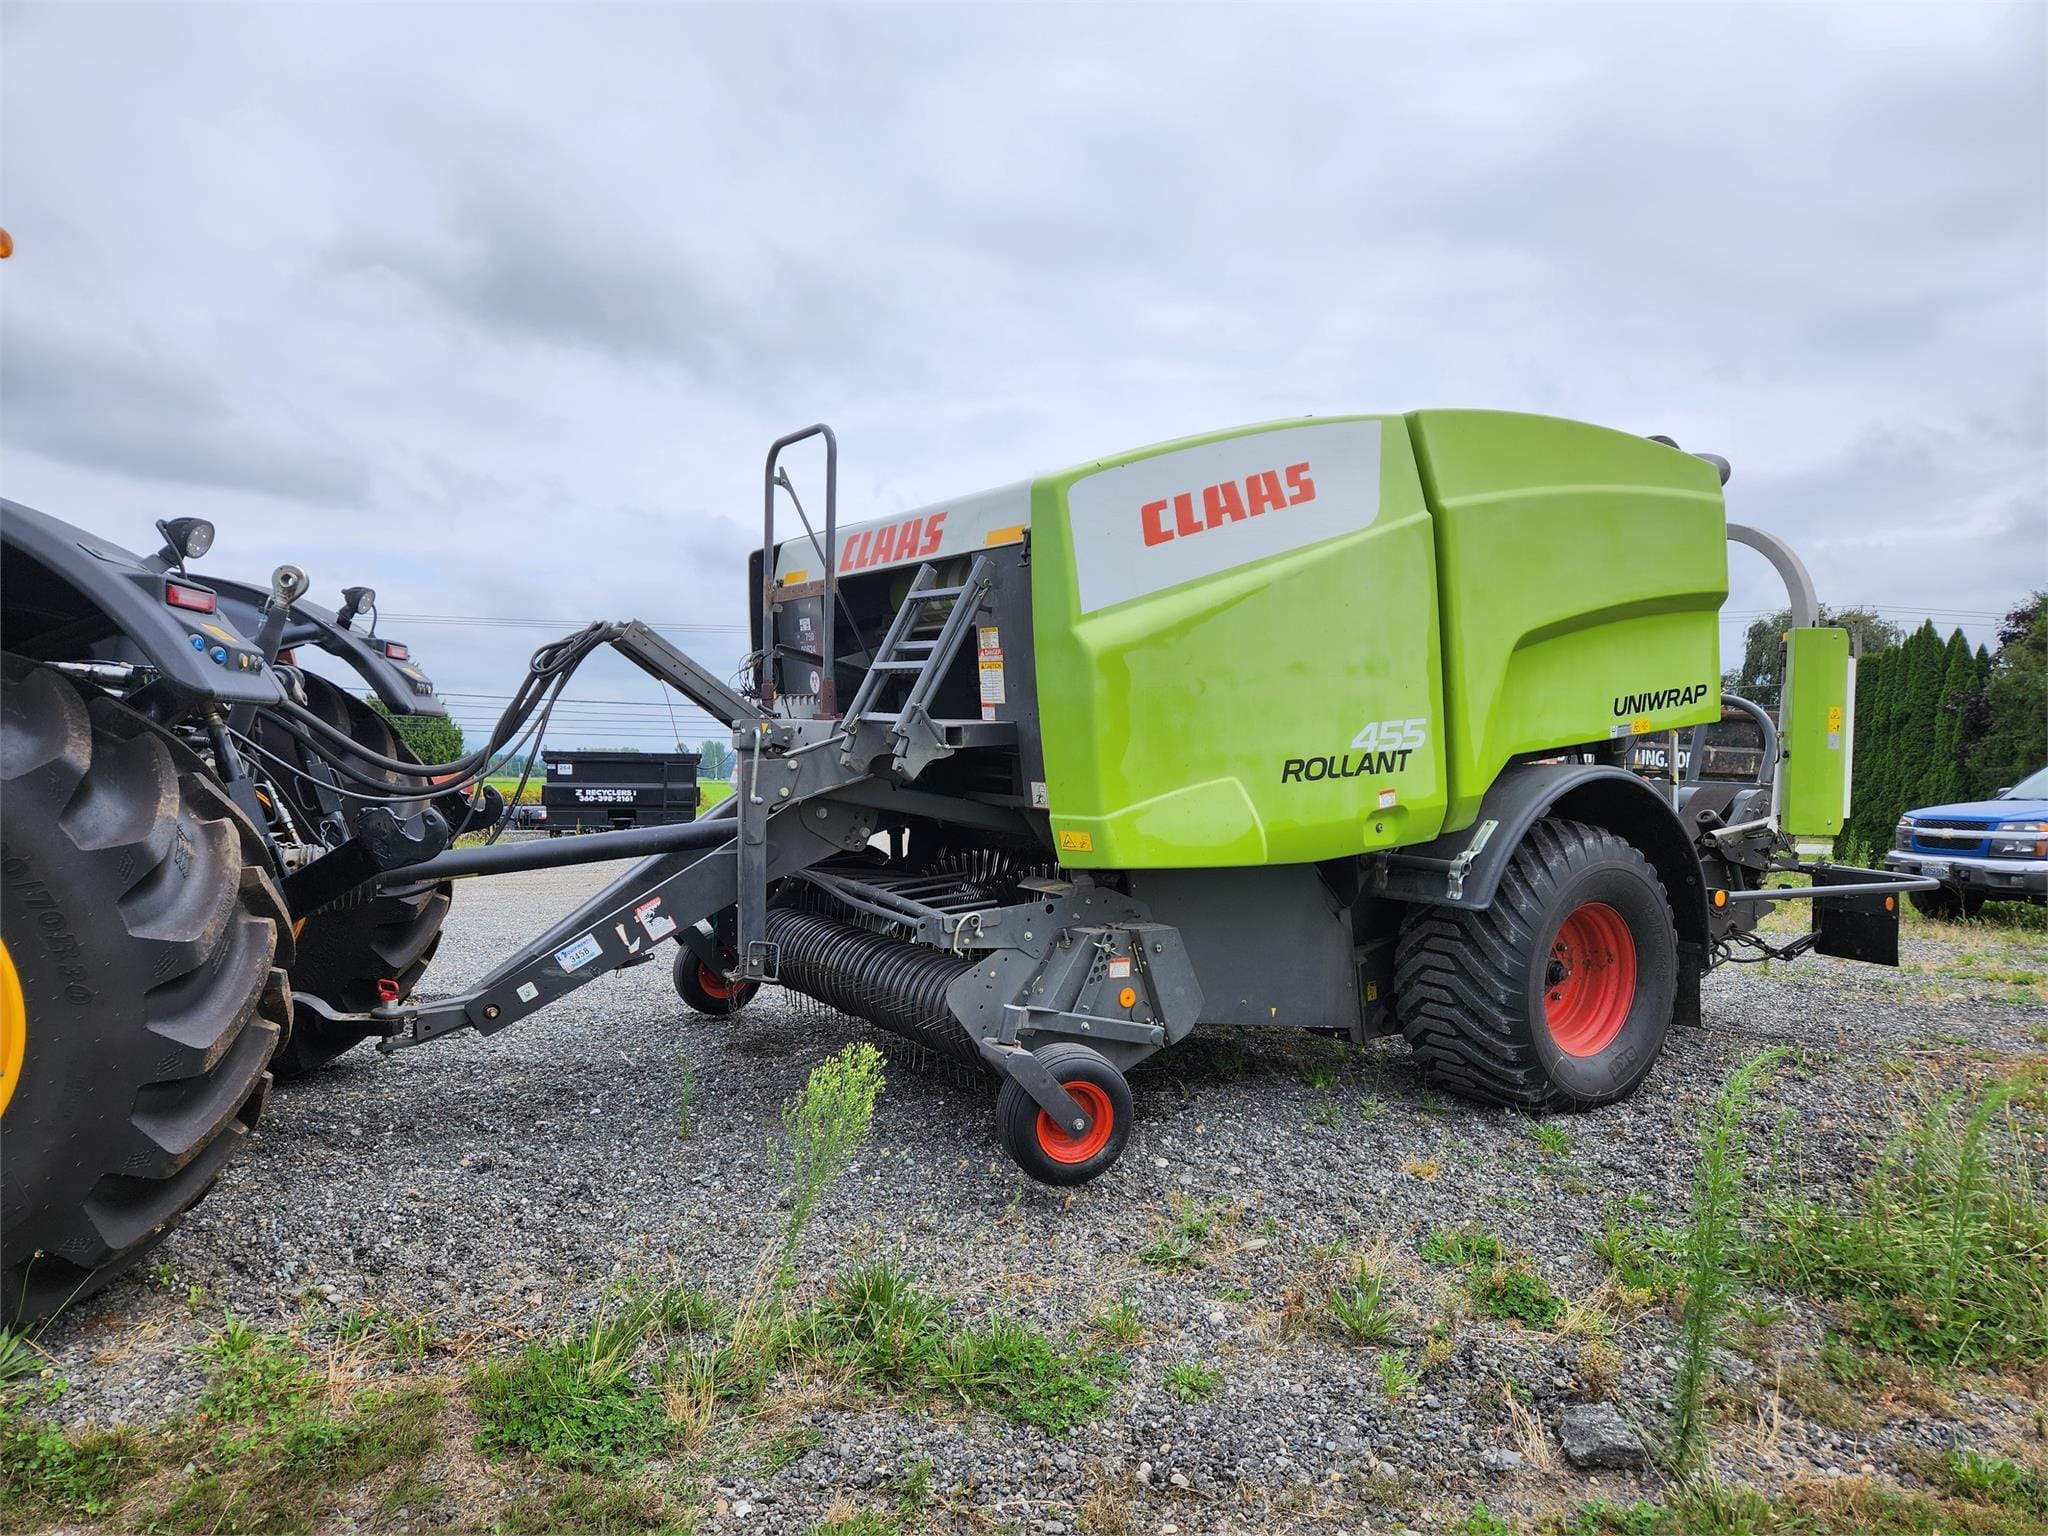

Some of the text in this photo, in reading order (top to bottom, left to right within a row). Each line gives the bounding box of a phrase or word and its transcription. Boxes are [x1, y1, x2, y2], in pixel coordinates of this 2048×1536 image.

[1141, 462, 1316, 547] CLAAS
[839, 511, 948, 572] CLAAS
[1613, 684, 1708, 717] UNIWRAP
[1351, 718, 1428, 753] 455
[1281, 749, 1413, 784] ROLLANT
[585, 789, 633, 797] RECYCLERS
